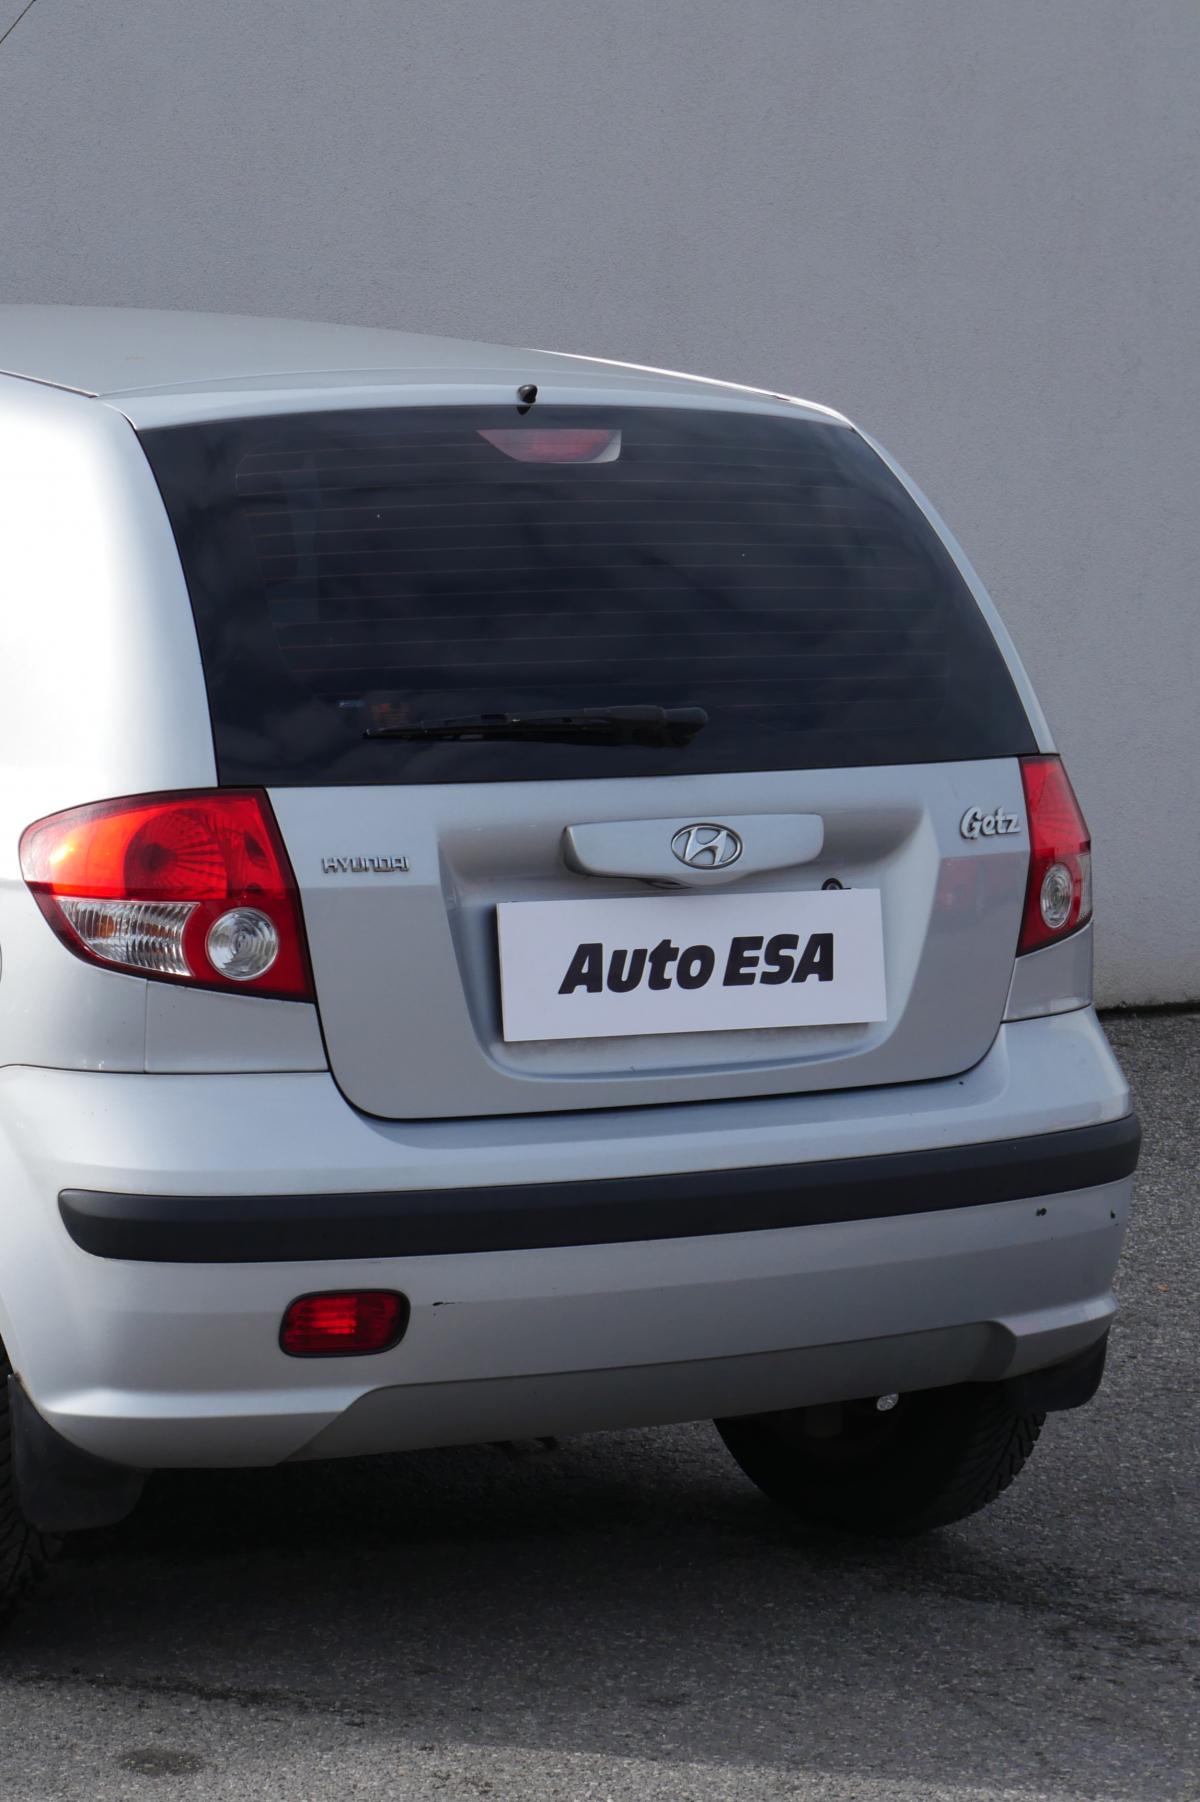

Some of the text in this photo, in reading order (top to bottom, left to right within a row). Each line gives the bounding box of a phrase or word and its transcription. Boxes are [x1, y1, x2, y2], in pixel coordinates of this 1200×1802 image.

[960, 806, 1021, 840] Getz
[321, 856, 409, 873] HYUNDAI
[558, 933, 834, 994] Auto ESA
